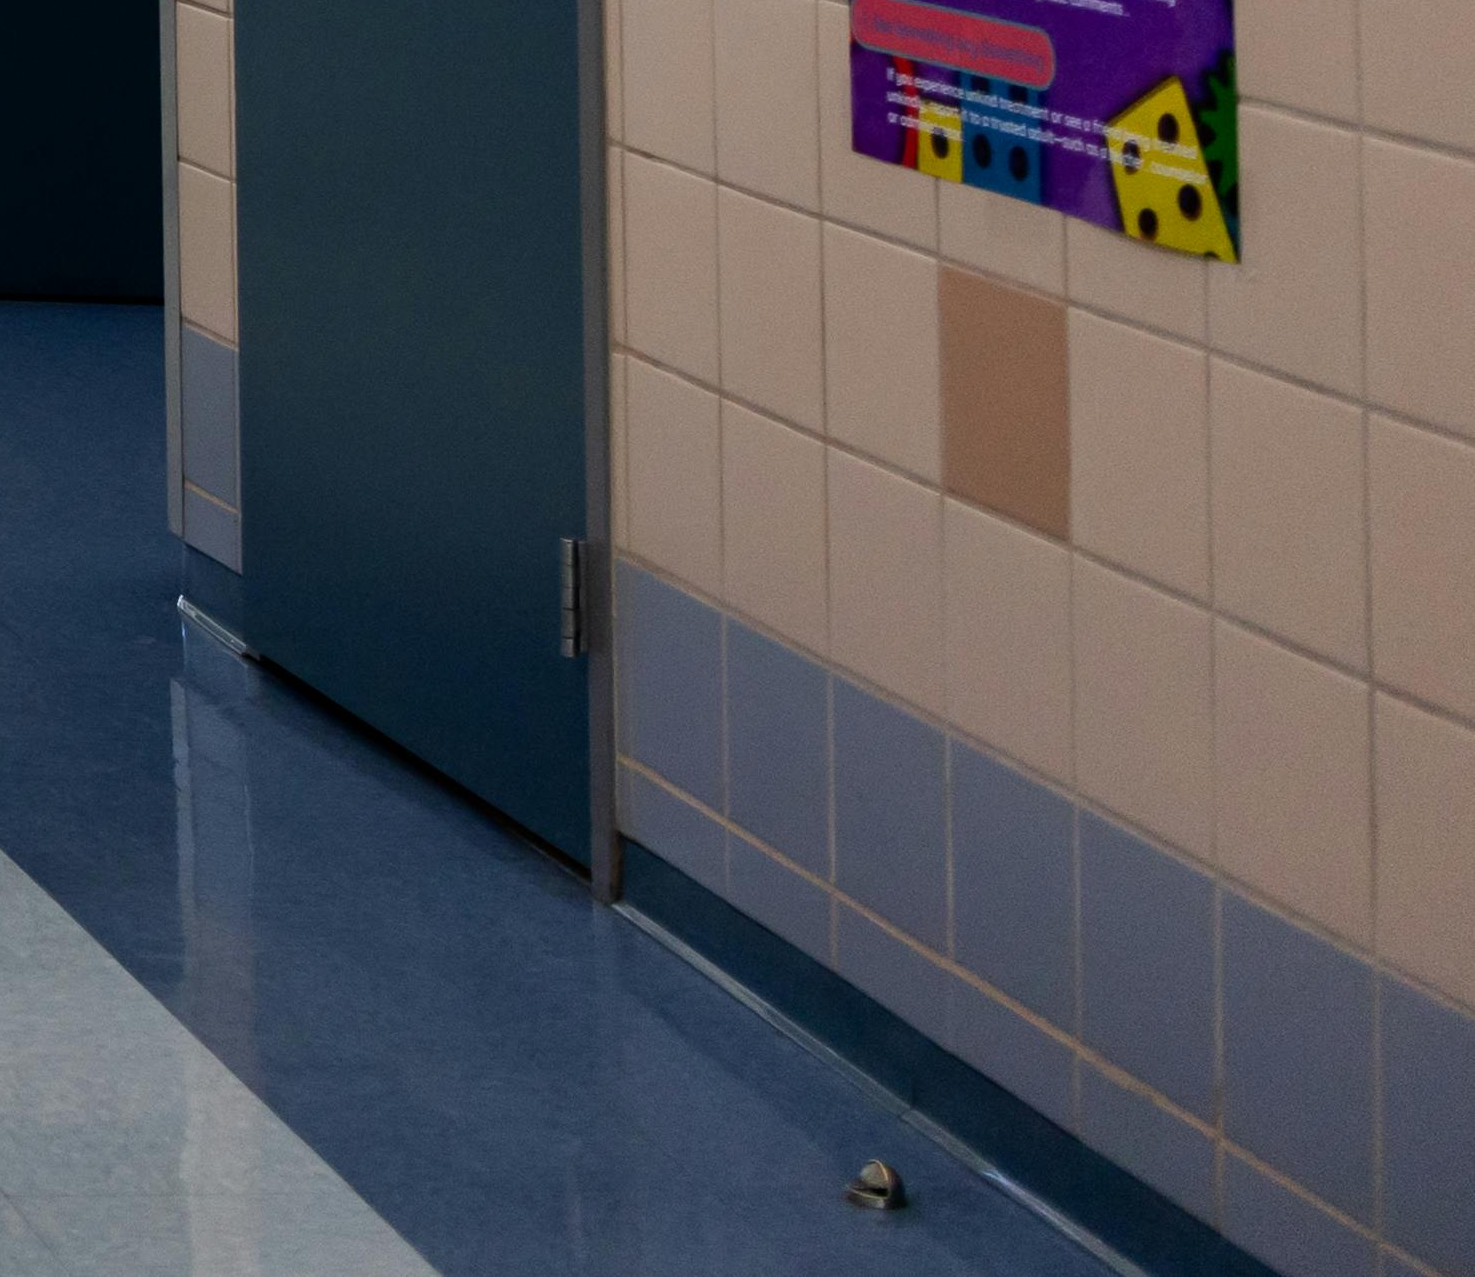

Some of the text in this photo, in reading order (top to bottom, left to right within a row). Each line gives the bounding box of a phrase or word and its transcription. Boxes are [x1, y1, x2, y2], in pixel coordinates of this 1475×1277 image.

[914, 77, 965, 98] experience
[999, 96, 1049, 121] treatment
[1051, 111, 1062, 124] or
[1064, 115, 1082, 130] see
[991, 115, 1027, 137] trusted
